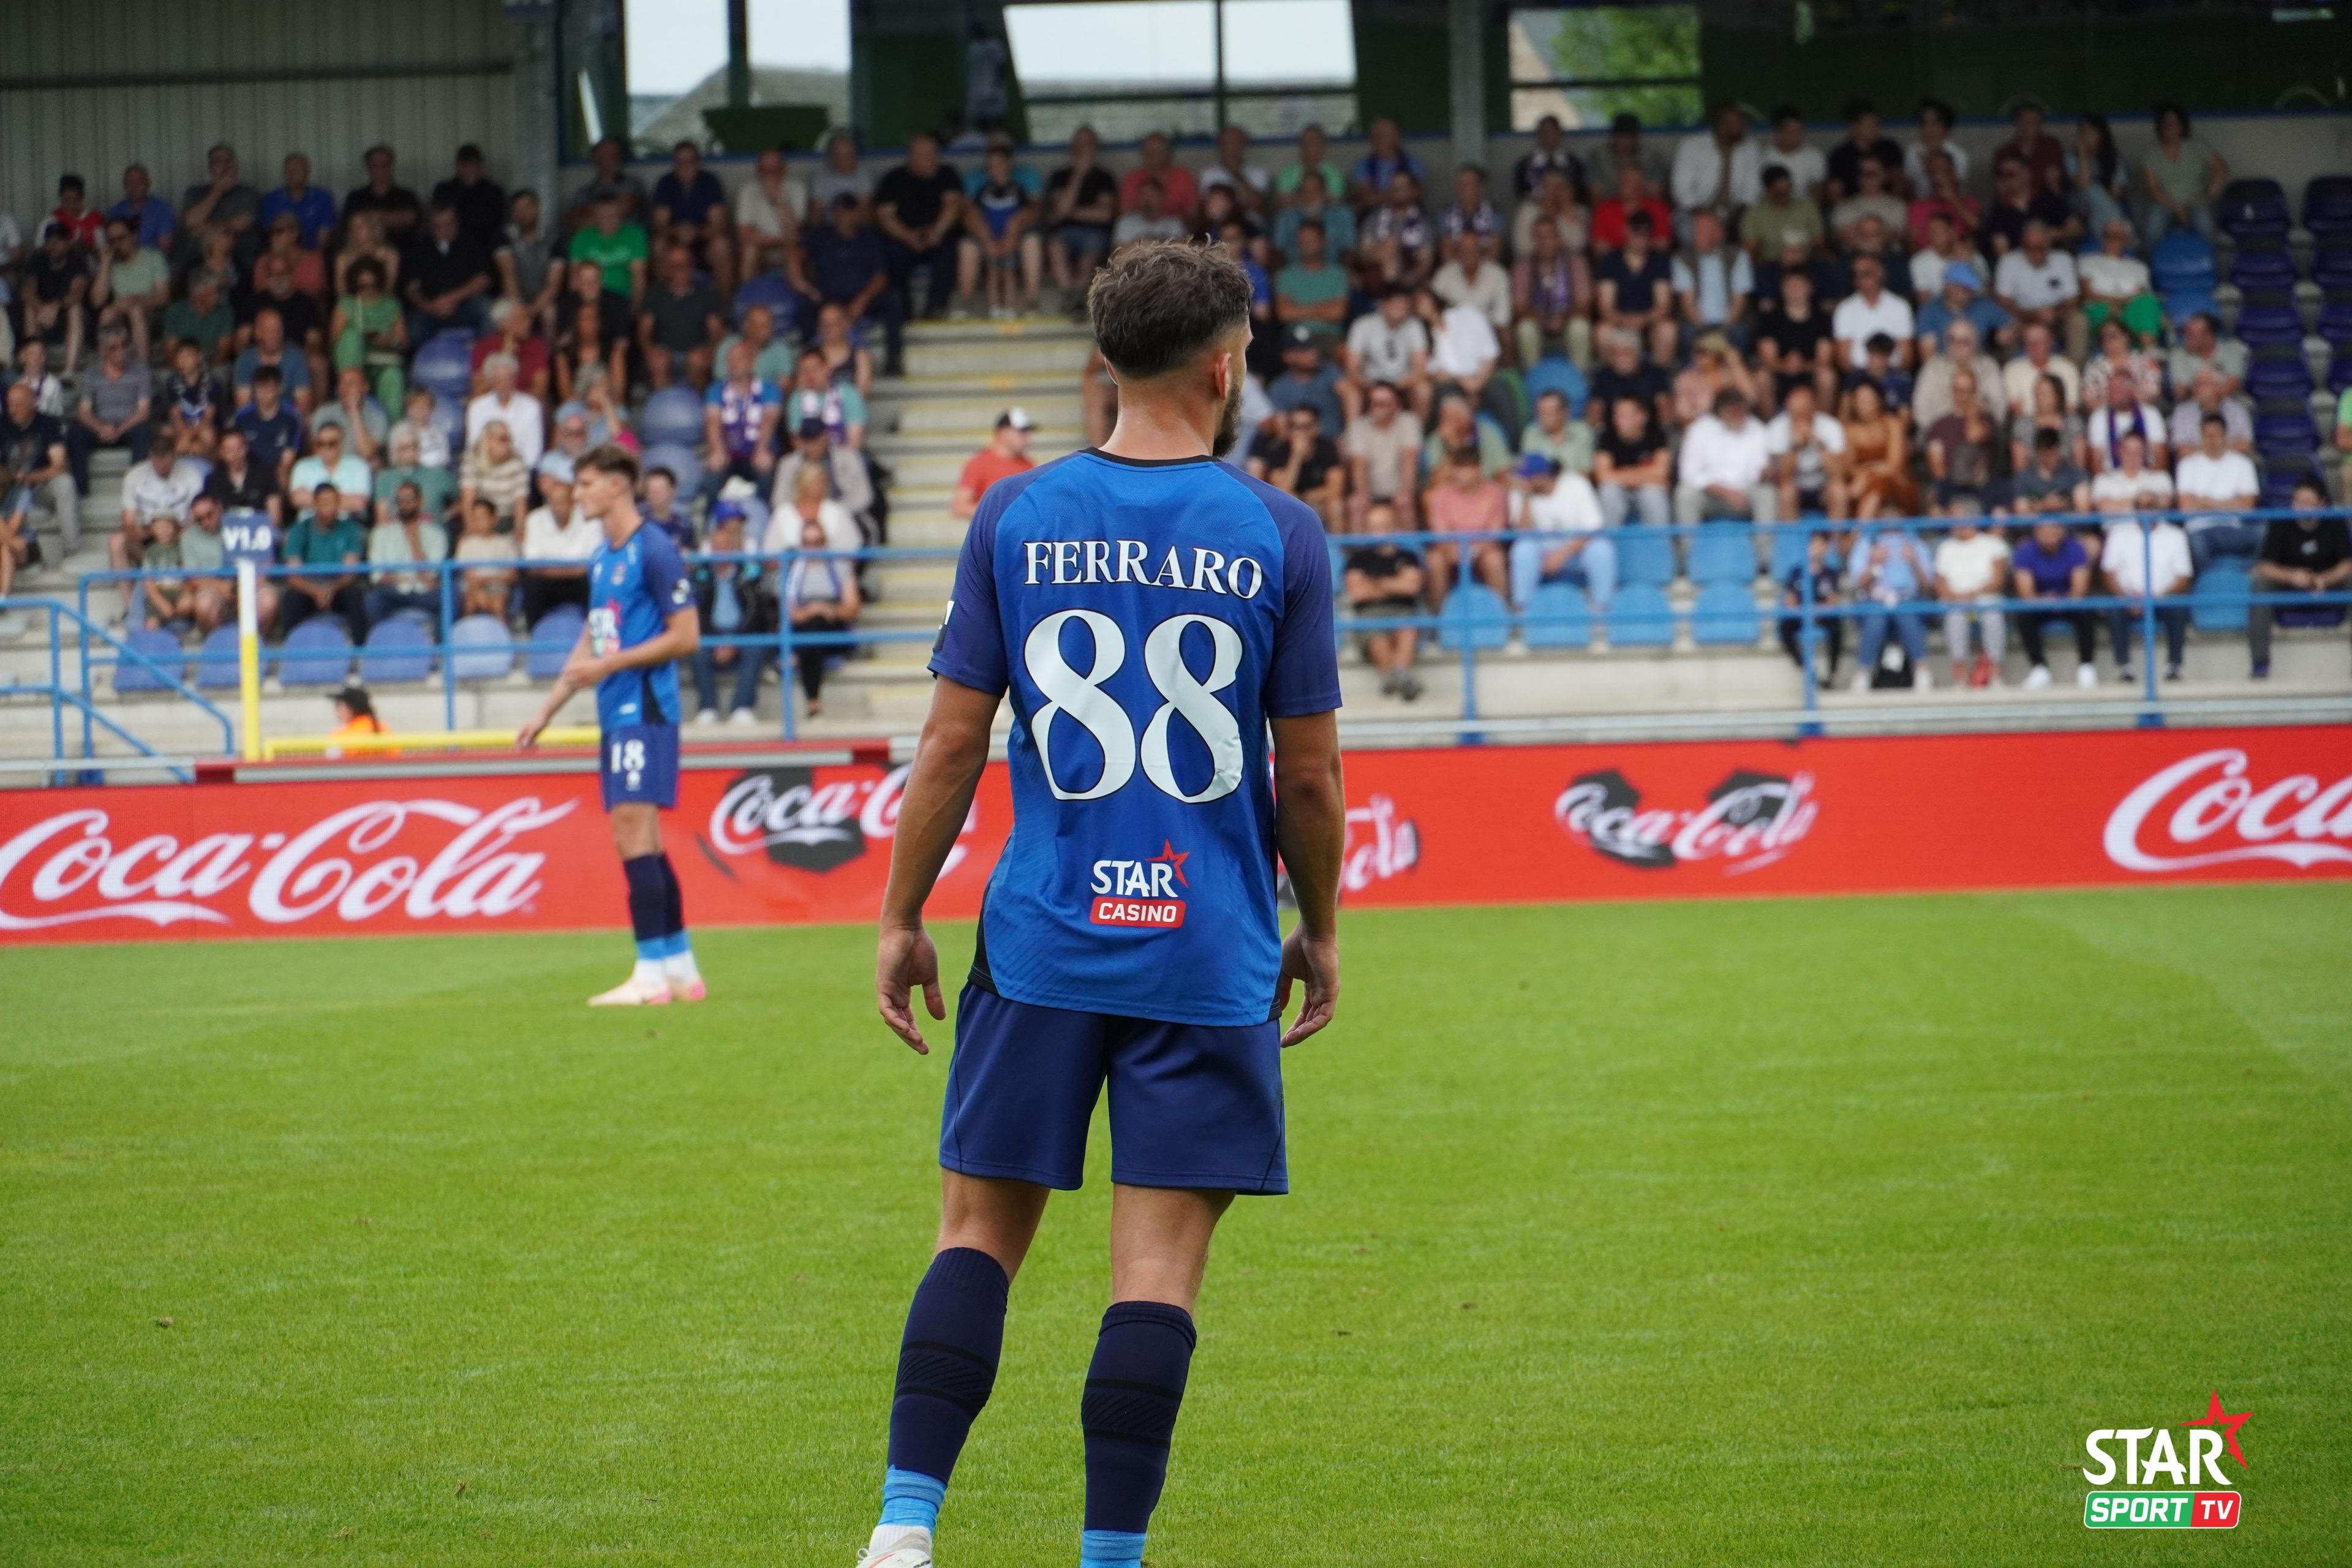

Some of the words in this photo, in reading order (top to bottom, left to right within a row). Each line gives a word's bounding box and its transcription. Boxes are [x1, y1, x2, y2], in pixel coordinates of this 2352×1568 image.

[1023, 540, 1262, 599] FERRARO
[1024, 609, 1243, 804] 88
[611, 739, 646, 774] 18
[709, 764, 978, 854] Coca-C
[0, 796, 579, 929] Coca-Cola
[1091, 860, 1179, 898] STAR
[1098, 902, 1177, 922] CASINO
